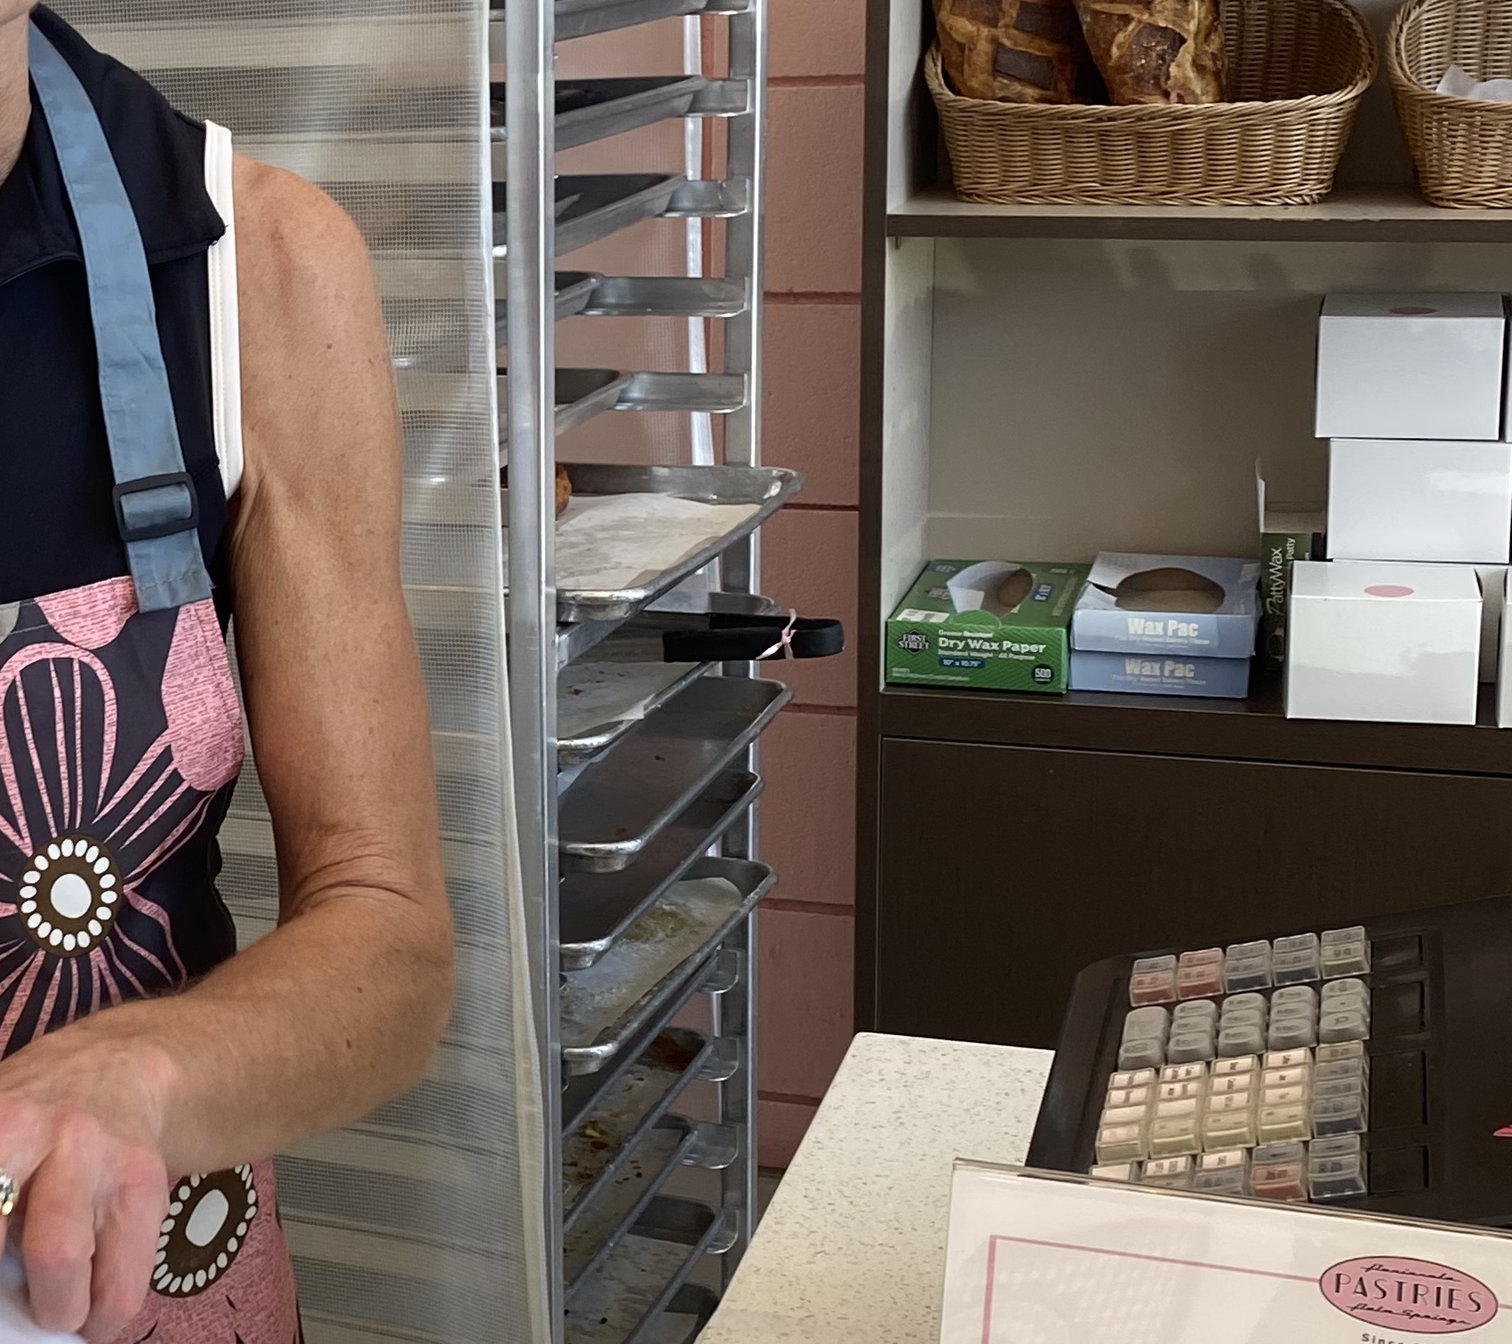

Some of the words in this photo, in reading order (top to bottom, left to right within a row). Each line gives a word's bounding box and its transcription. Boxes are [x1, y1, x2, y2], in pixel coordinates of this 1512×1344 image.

[1266, 548, 1286, 616] PattyWax
[1127, 617, 1164, 635] Wax
[1168, 619, 1199, 637] Pac
[902, 633, 927, 643] FIRST
[939, 637, 966, 650] Dry
[968, 639, 1000, 650] Wax
[1002, 641, 1047, 653] Paper
[1035, 668, 1052, 678] 500
[1125, 659, 1161, 675] Wax
[1164, 660, 1195, 677] Pac
[1335, 1273, 1482, 1313] PASTRIES
